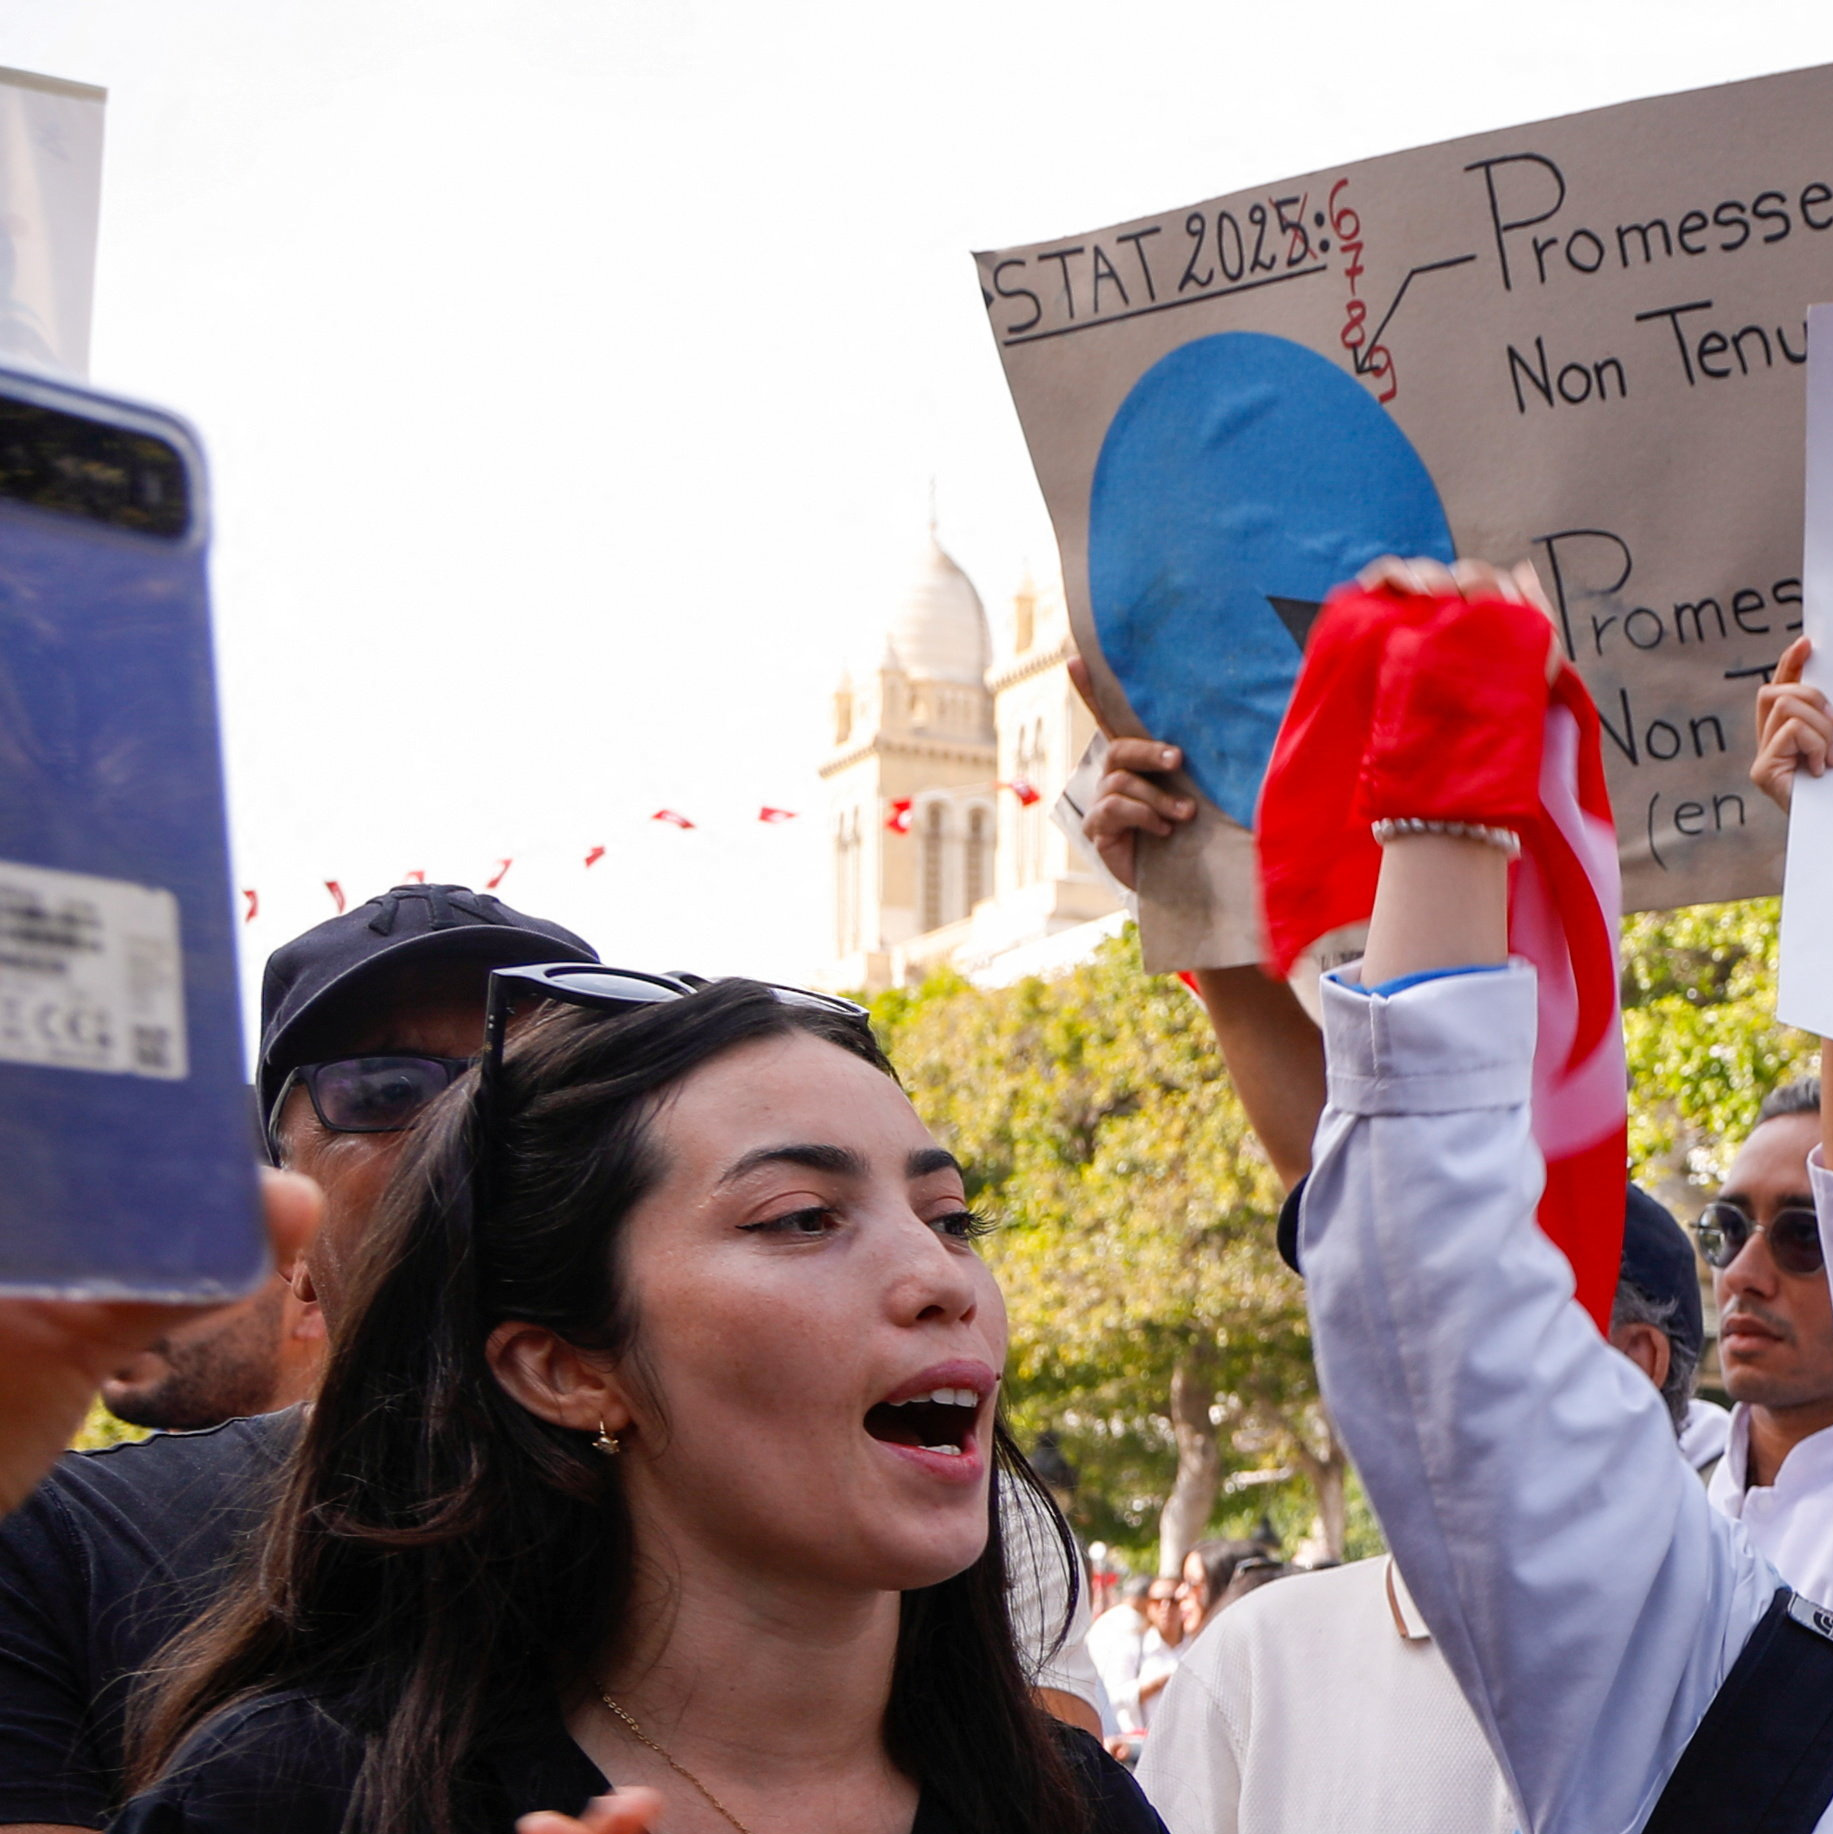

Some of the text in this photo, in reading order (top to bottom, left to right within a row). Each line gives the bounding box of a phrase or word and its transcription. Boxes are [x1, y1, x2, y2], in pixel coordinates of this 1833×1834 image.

[993, 227, 1161, 333] STAT
[1506, 337, 1627, 413] Non
[1648, 792, 1745, 871] (en
